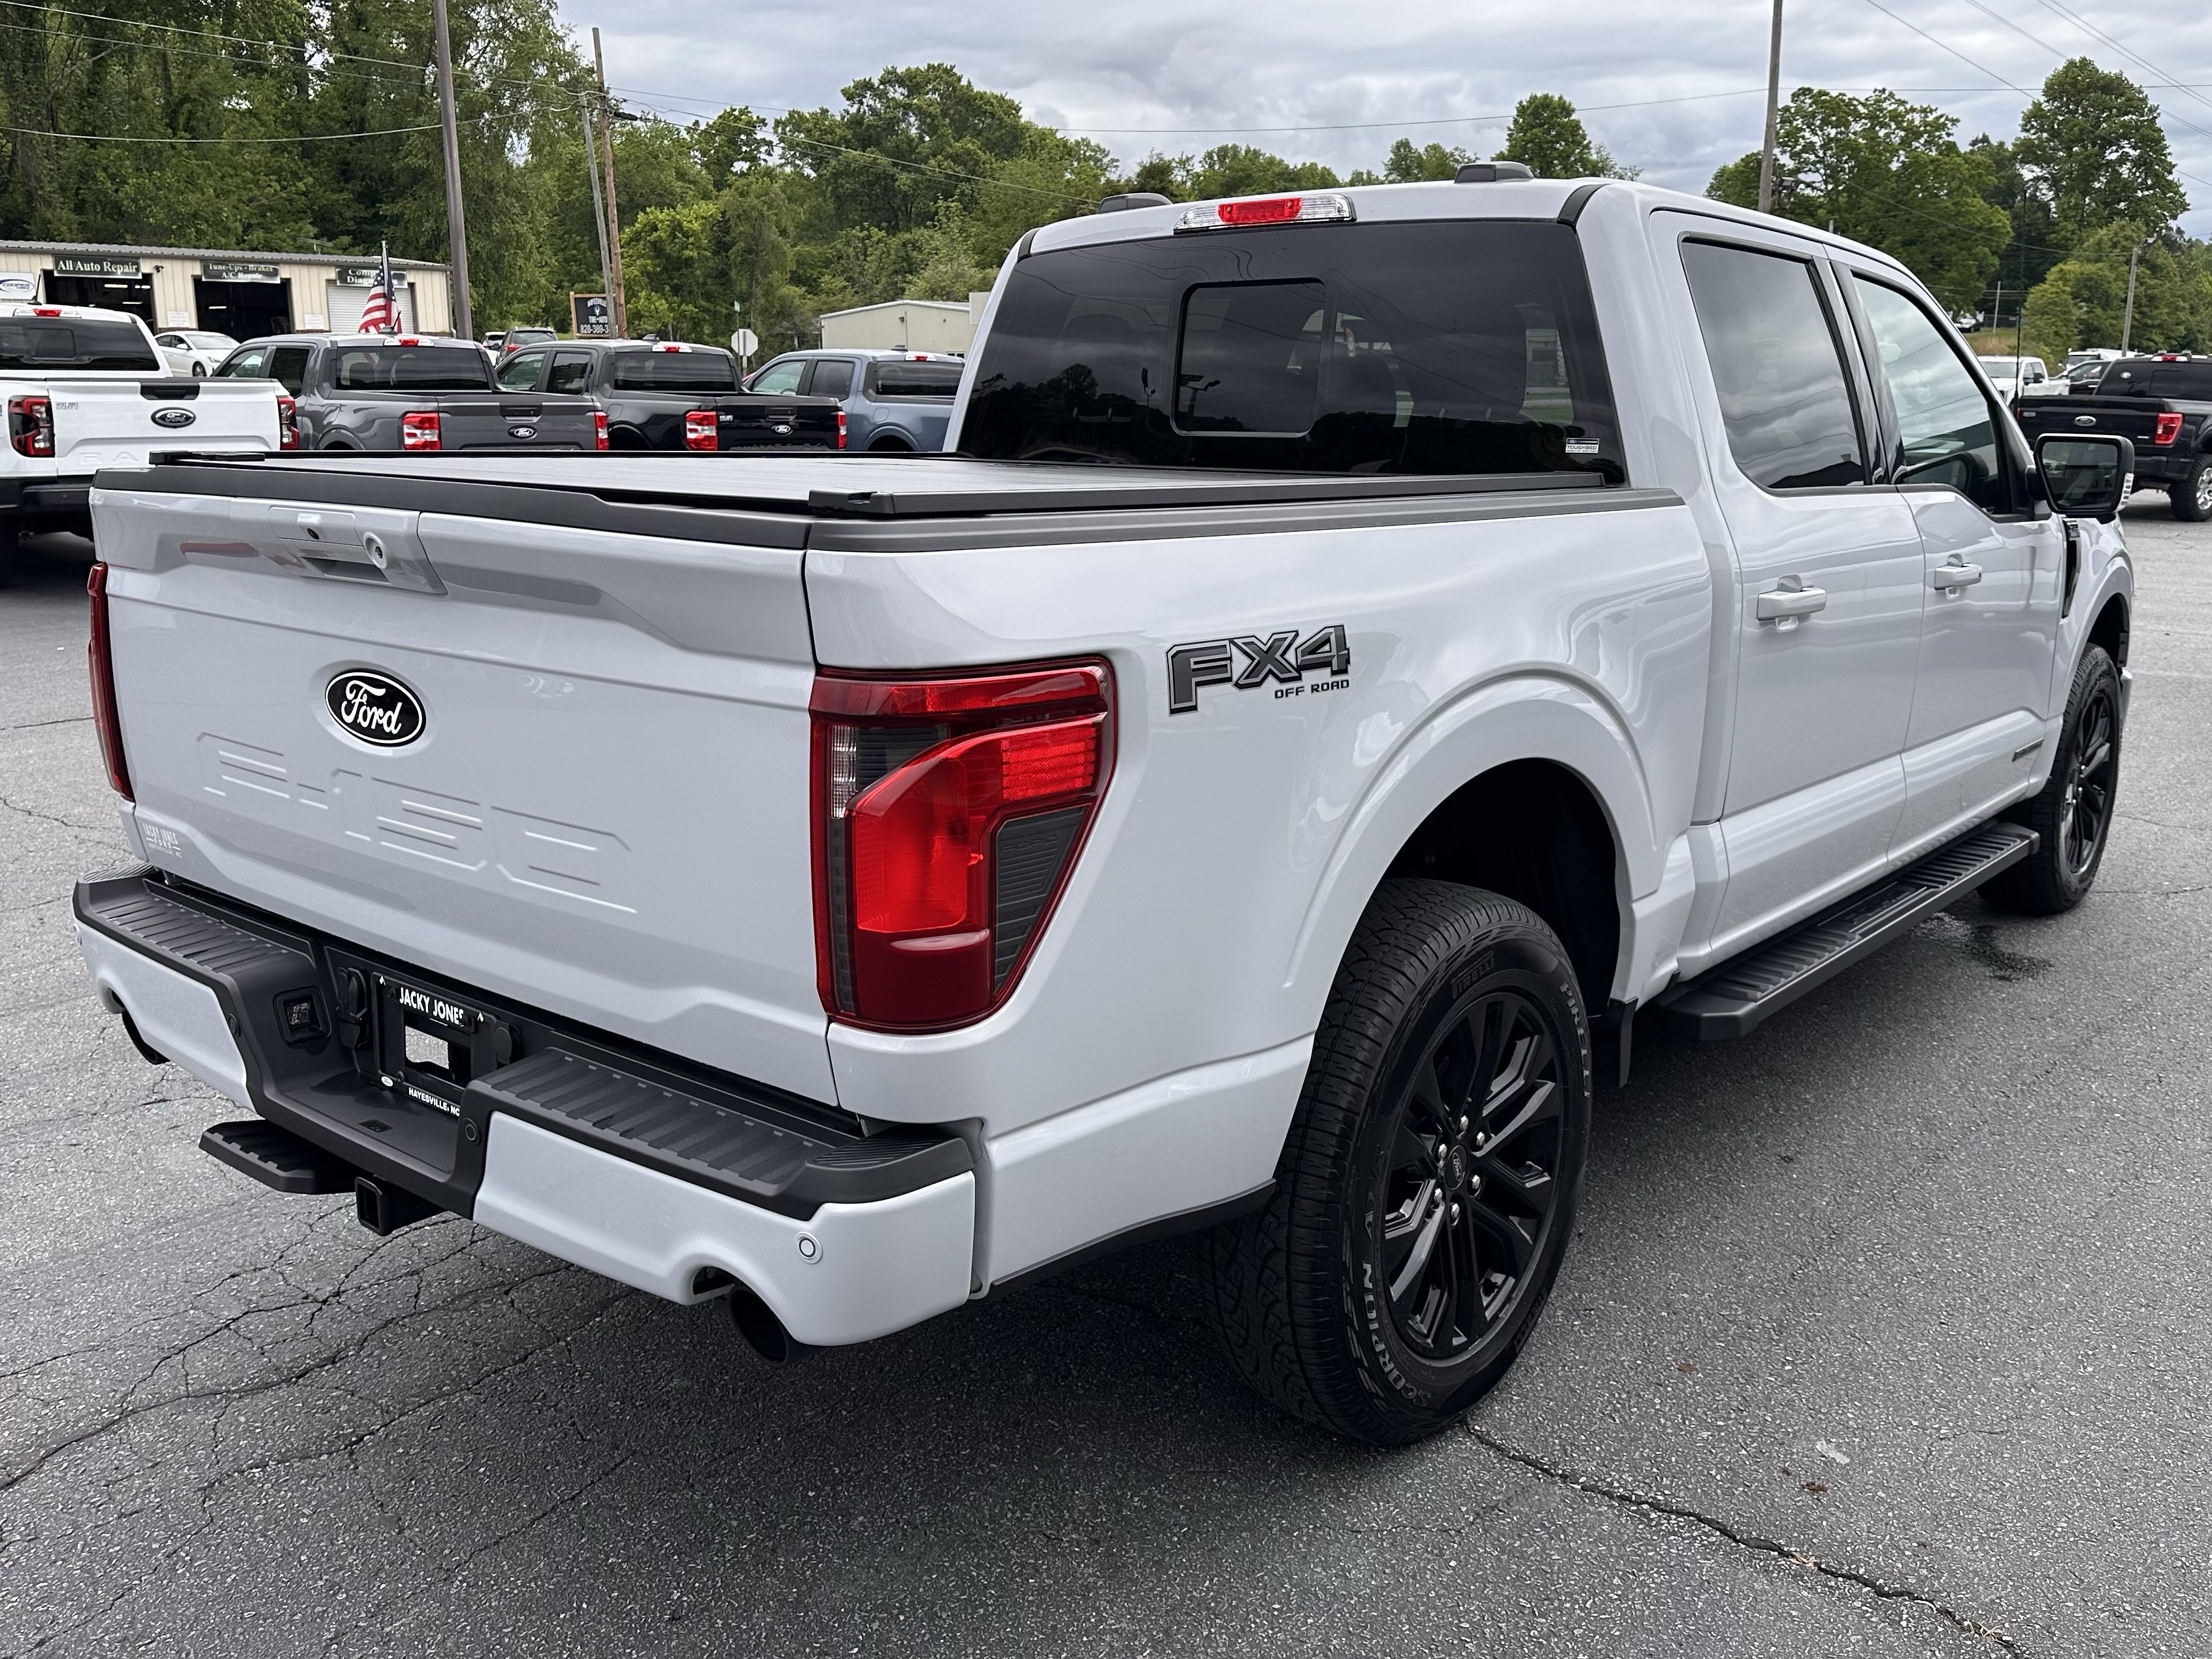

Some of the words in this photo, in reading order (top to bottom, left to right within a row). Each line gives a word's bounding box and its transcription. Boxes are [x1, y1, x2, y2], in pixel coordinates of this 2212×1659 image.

[58, 260, 73, 271] All
[74, 261, 101, 272] Auto
[103, 261, 137, 275] Repair
[580, 324, 619, 334] 828-389-31
[1166, 623, 1351, 716] FX4
[1274, 685, 1305, 699] OFF
[1310, 679, 1350, 694] ROAD
[341, 680, 403, 734] Ford
[195, 731, 638, 913] F-150
[399, 987, 430, 1013] JACKY
[433, 999, 465, 1027] JONES
[1559, 982, 1591, 1098] PIRELLI
[450, 1105, 460, 1117] NC
[1362, 1260, 1432, 1407] SCORPION
